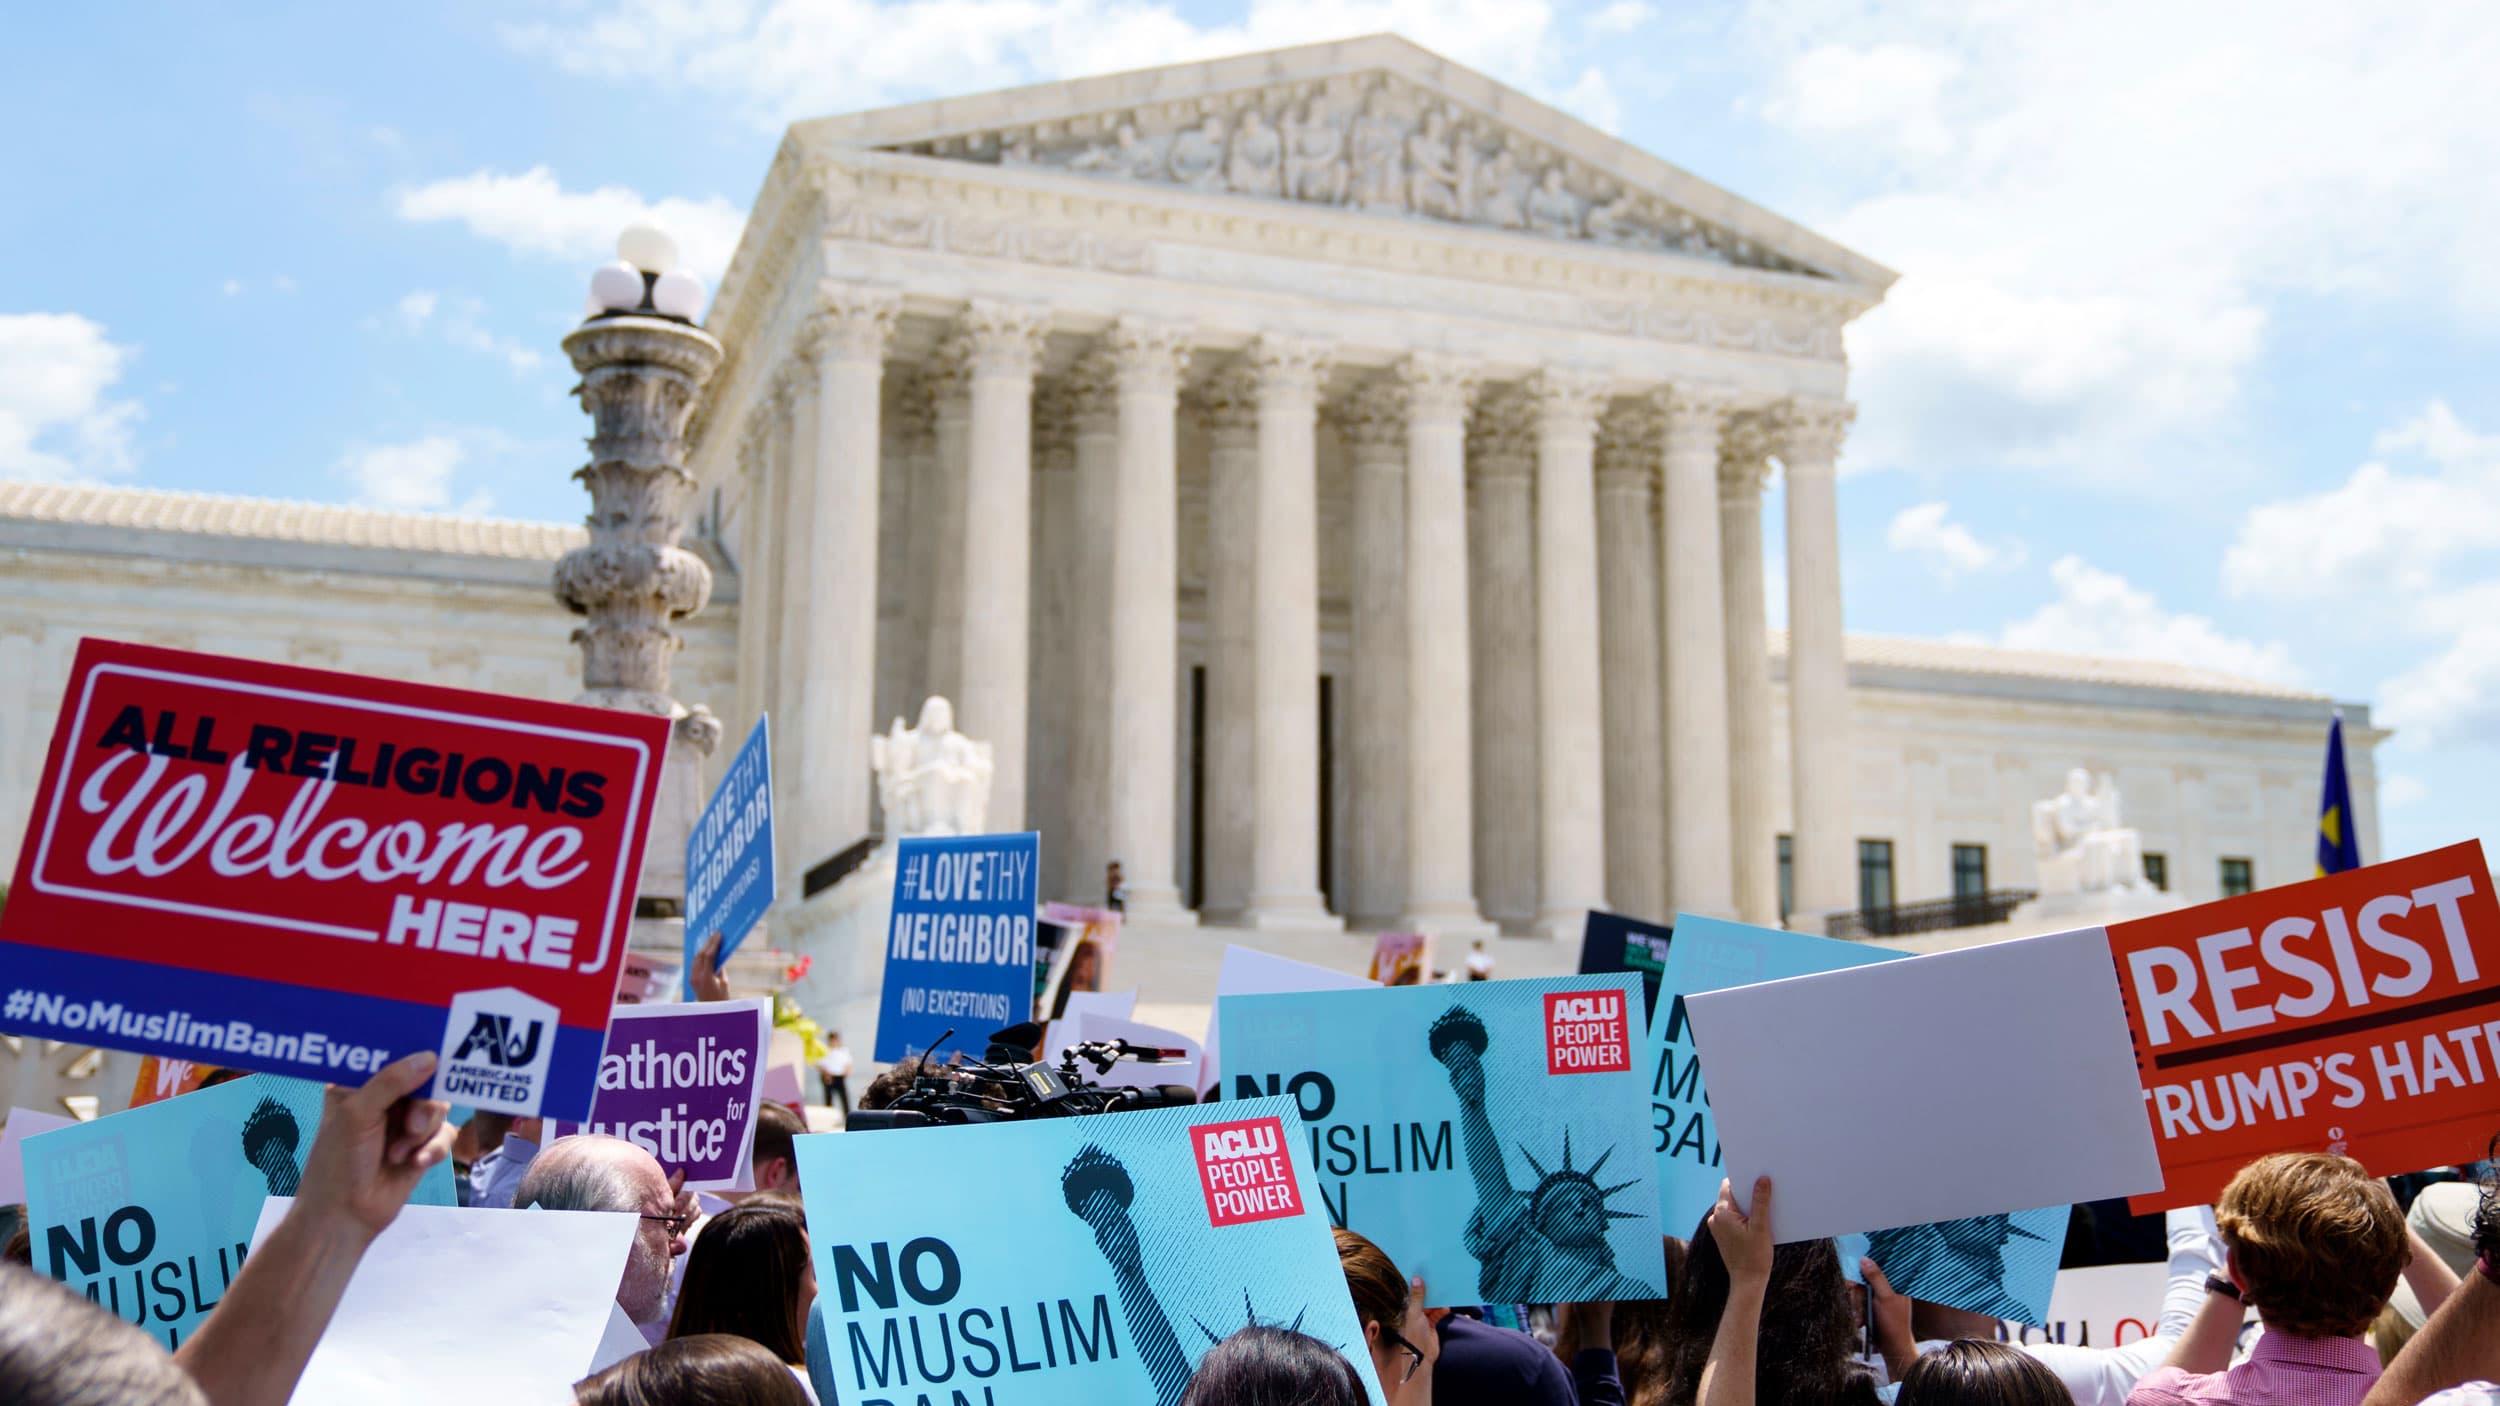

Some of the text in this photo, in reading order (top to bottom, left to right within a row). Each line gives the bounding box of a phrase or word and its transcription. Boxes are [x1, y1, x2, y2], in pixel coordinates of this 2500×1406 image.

[97, 705, 607, 819] ALL RELIGIONS
[79, 744, 590, 889] Welcome
[686, 782, 768, 929] NEIGHBOR
[903, 850, 1030, 901] #LOVETHY
[386, 895, 579, 969] HERE
[892, 913, 1029, 966] NEIGHBOR
[2127, 875, 2480, 1046] RESIST
[3, 989, 389, 1074] #NoMuslimBanEver
[902, 986, 1010, 1026] (NO EXCEPTIONS)
[1553, 997, 1618, 1023] ACLU
[1553, 1022, 1621, 1045] PEOPLE
[1555, 1044, 1622, 1068] POWER
[445, 1076, 529, 1102] UNITED
[449, 1064, 532, 1085] AMERICANS
[600, 1036, 746, 1090] atholics
[578, 1104, 726, 1163] stice
[727, 1097, 745, 1120] for
[1204, 1126, 1277, 1161] ACLU
[1207, 1157, 1286, 1189] PEOPLE
[1214, 1184, 1294, 1217] POWER
[47, 1206, 156, 1281] NO
[831, 1236, 961, 1312] NO
[847, 1294, 1118, 1390] MUSLIM
